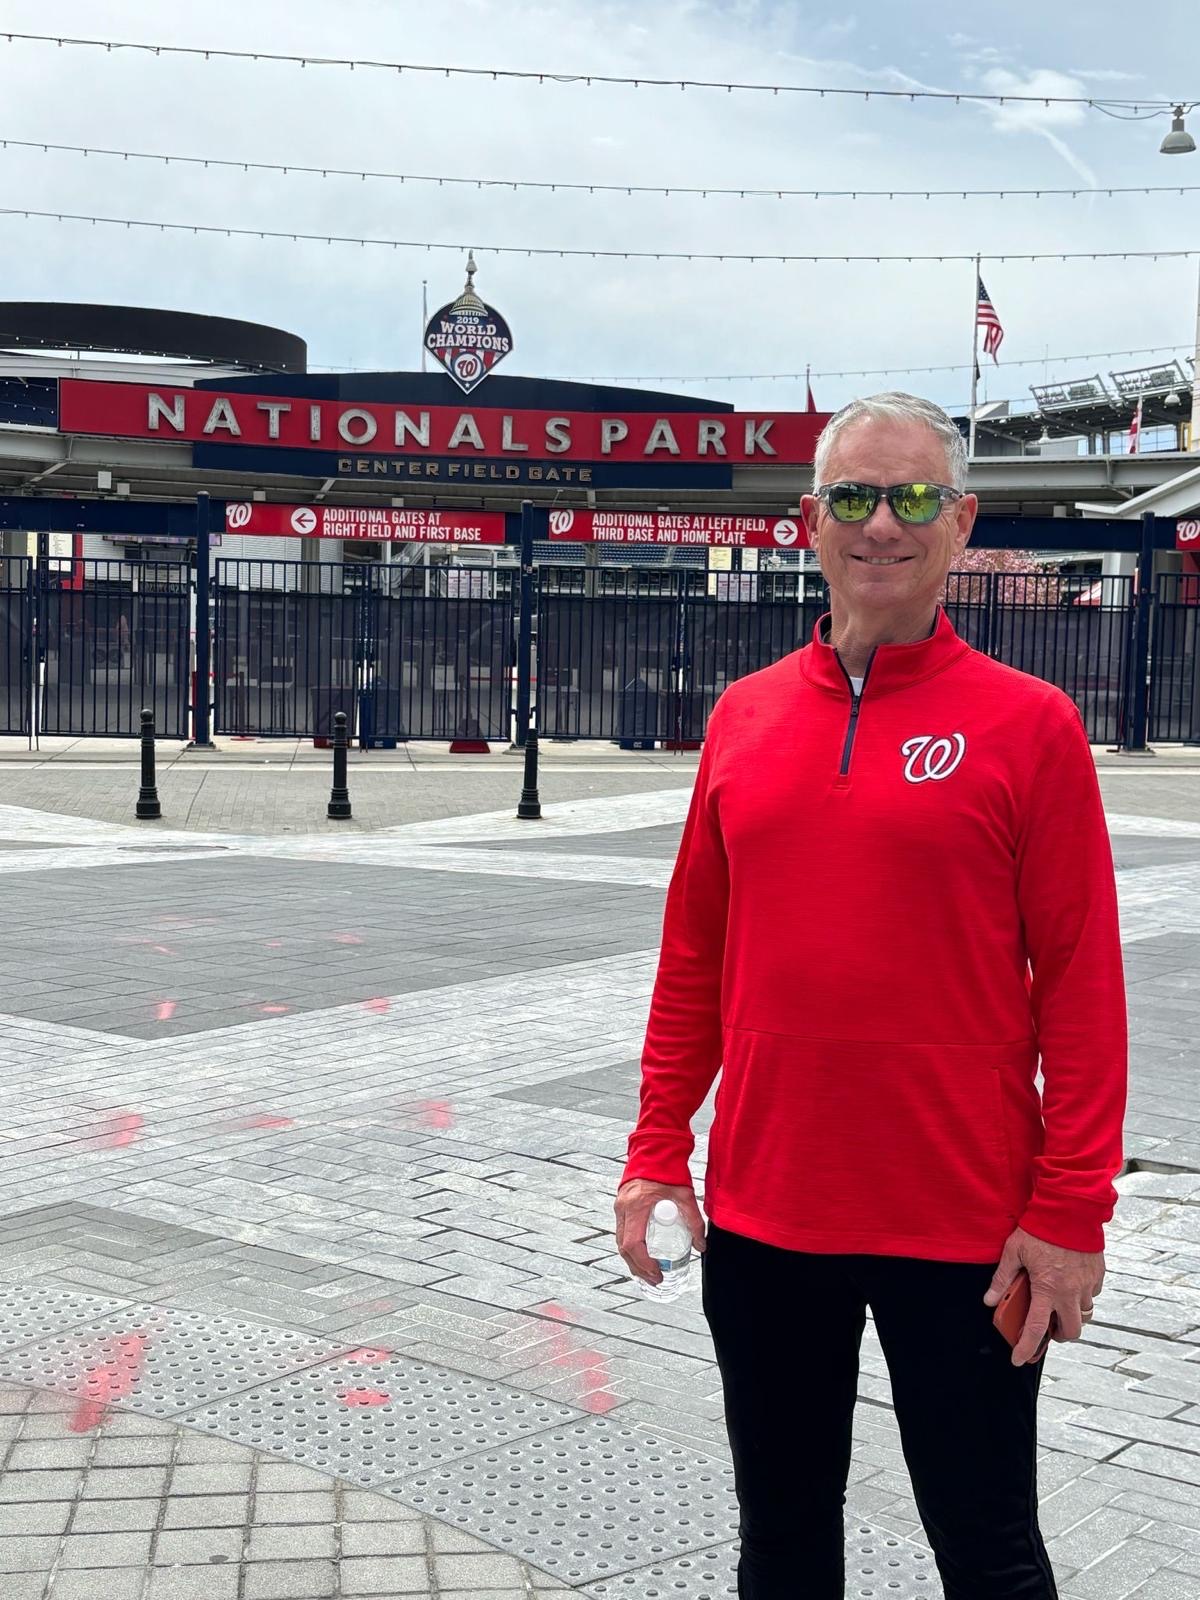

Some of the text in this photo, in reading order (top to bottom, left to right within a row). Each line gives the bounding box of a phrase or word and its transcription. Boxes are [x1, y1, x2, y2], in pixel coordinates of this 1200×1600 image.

[440, 320, 497, 336] WORLD
[456, 316, 480, 325] 2019
[427, 333, 509, 352] CHAMPIONS
[148, 392, 777, 456] NATIONALS PARK
[338, 458, 592, 482] CENTER FIELD GATE
[323, 508, 441, 526] ADDITIONAL GATES AT
[592, 513, 769, 533] ADDITIONAL GATES AT LEFT FIELD,
[323, 522, 481, 541] RIGHT FIELD AND FIRST BASE
[592, 526, 746, 545] THIRD BASE AND HOME PLATE
[901, 731, 966, 784] W
